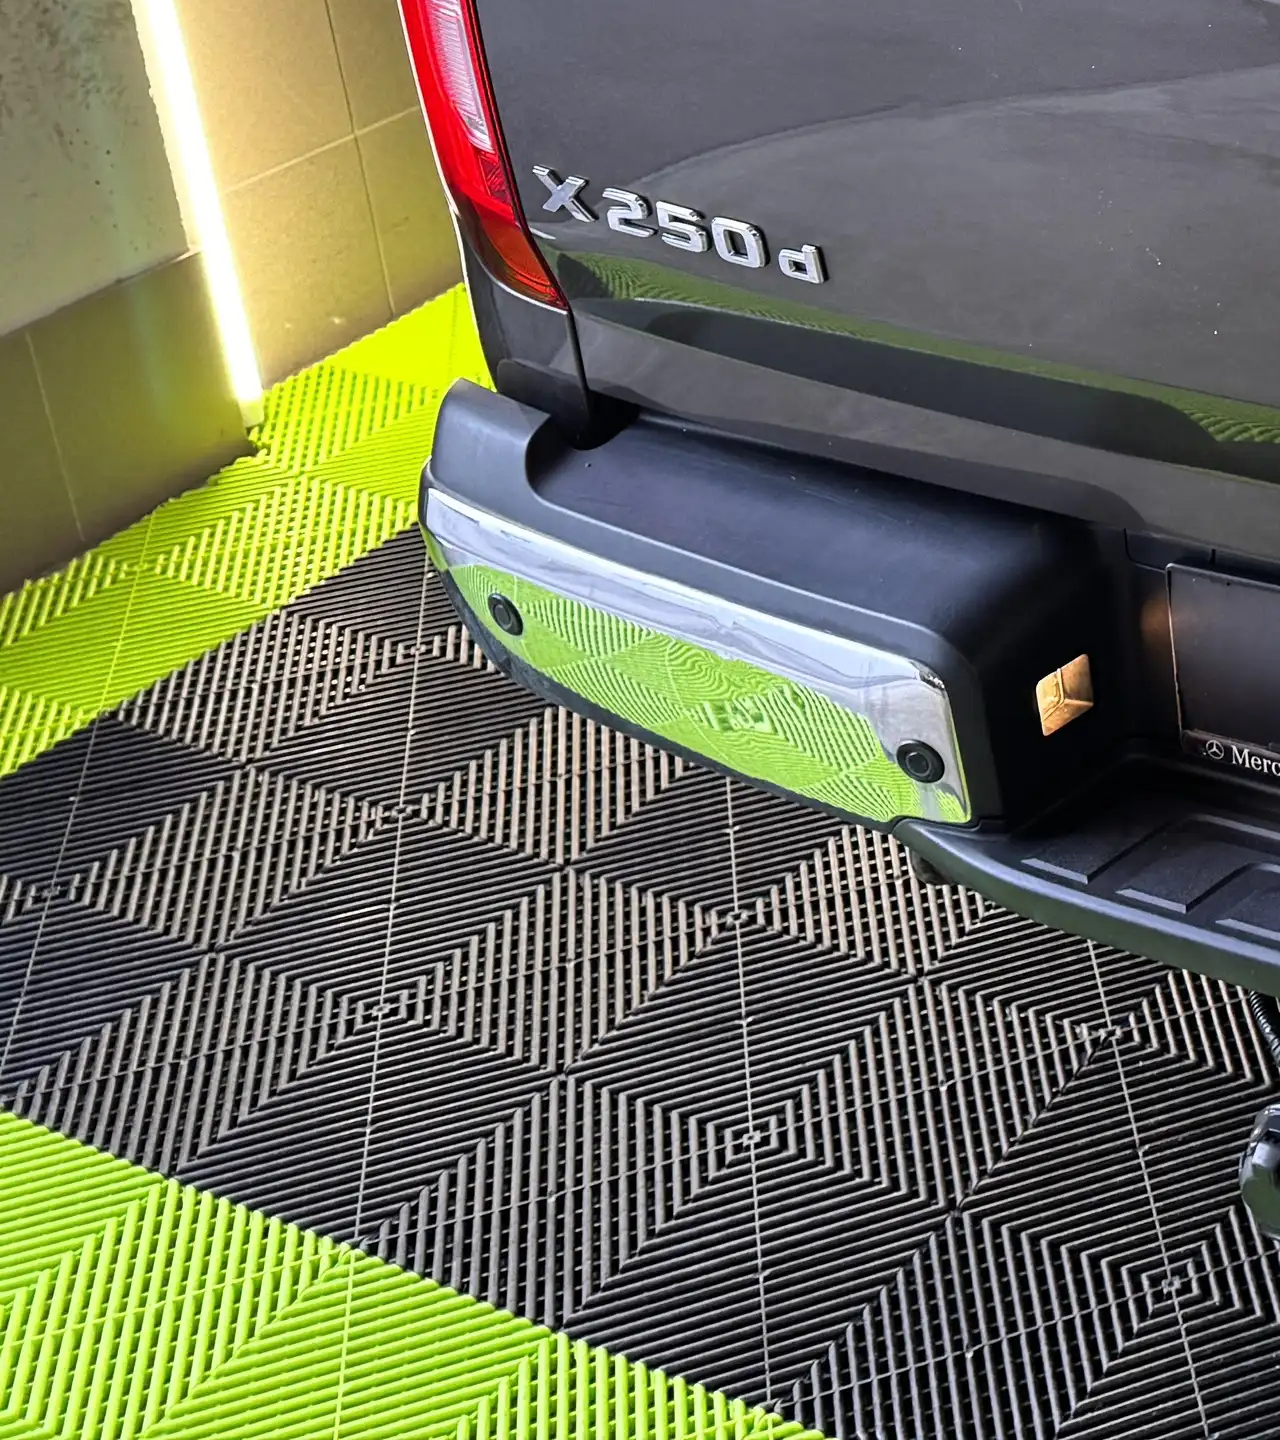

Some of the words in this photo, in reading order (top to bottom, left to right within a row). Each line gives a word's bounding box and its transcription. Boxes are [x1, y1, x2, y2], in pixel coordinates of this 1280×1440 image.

[533, 164, 598, 223] X
[602, 187, 768, 268] 250
[778, 244, 826, 284] d
